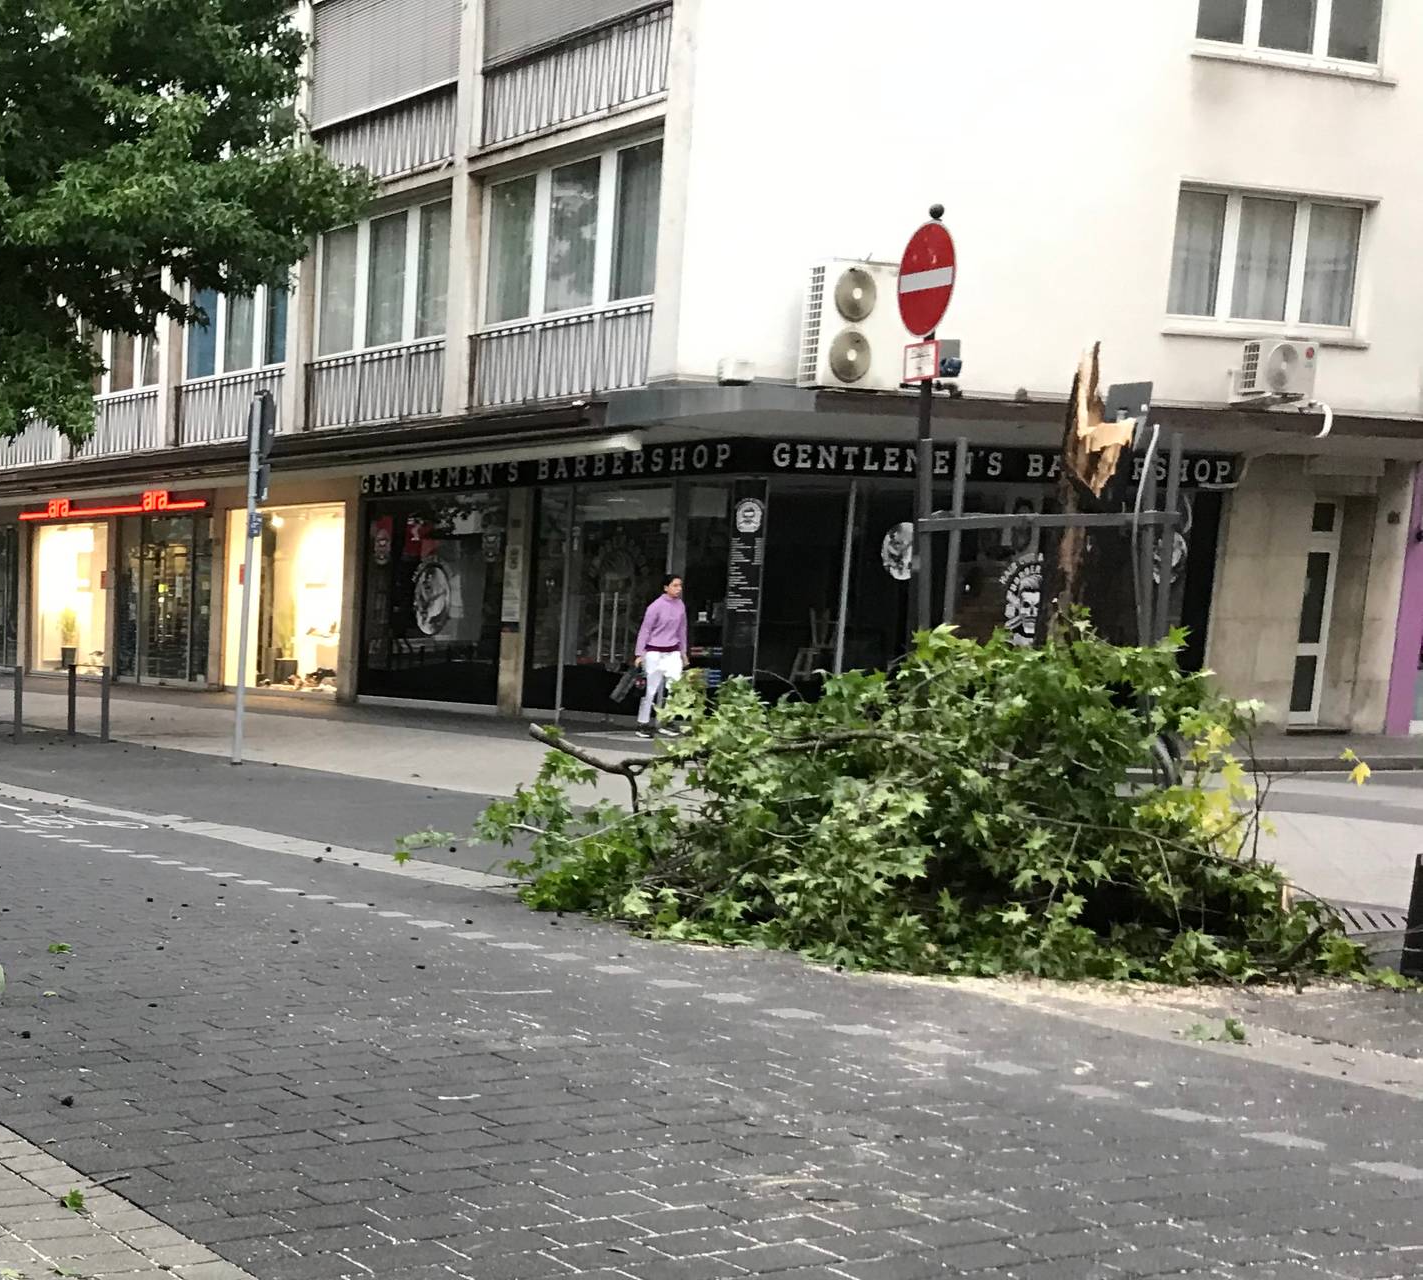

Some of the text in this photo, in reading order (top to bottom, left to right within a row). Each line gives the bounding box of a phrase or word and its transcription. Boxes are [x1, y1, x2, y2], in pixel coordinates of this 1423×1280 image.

[360, 443, 731, 494] GENTLEMEN'S BARBERSHOP
[1027, 453, 1231, 484] BARSHOP
[47, 498, 70, 518] ara
[142, 489, 169, 511] ara
